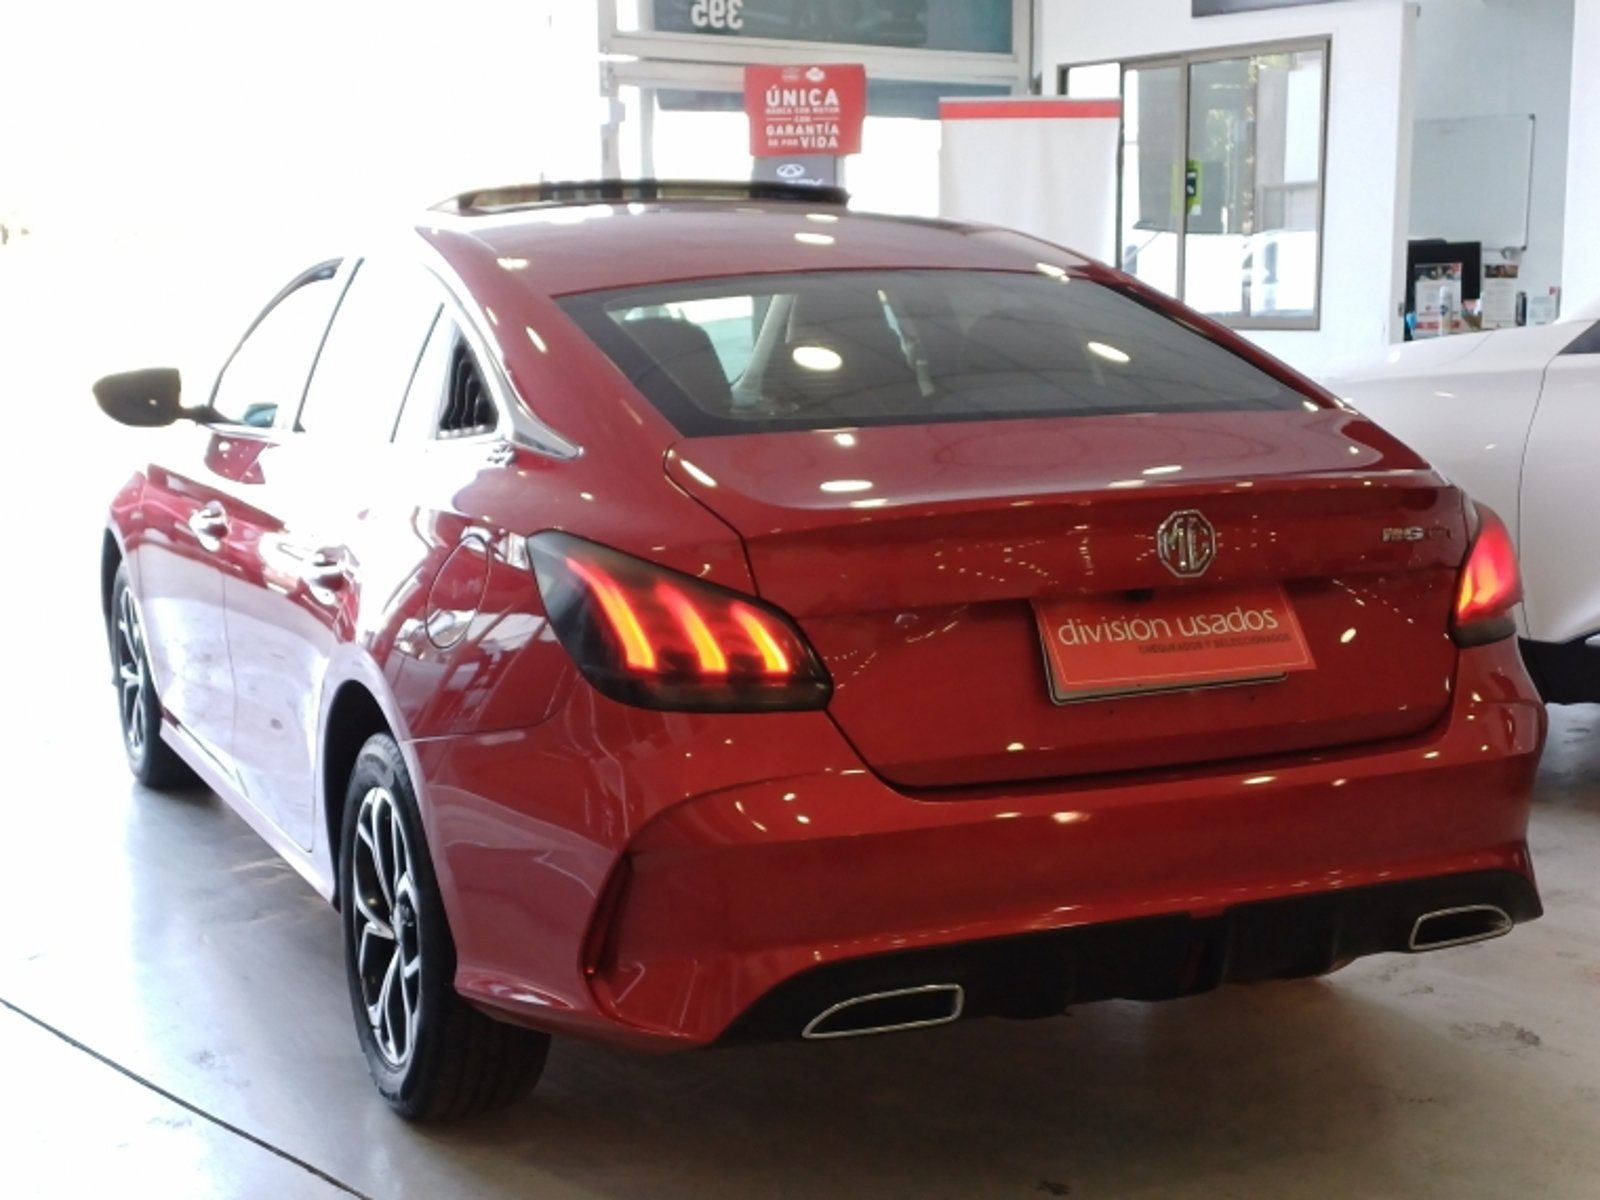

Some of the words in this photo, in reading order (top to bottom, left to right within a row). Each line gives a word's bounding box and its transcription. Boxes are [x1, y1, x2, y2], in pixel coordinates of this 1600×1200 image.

[765, 84, 840, 107] ÚNICA
[765, 121, 840, 136] GARANTÍA
[800, 136, 839, 148] VIDA
[1160, 515, 1213, 571] MG
[1057, 613, 1172, 646] división
[1176, 606, 1279, 638] usados
